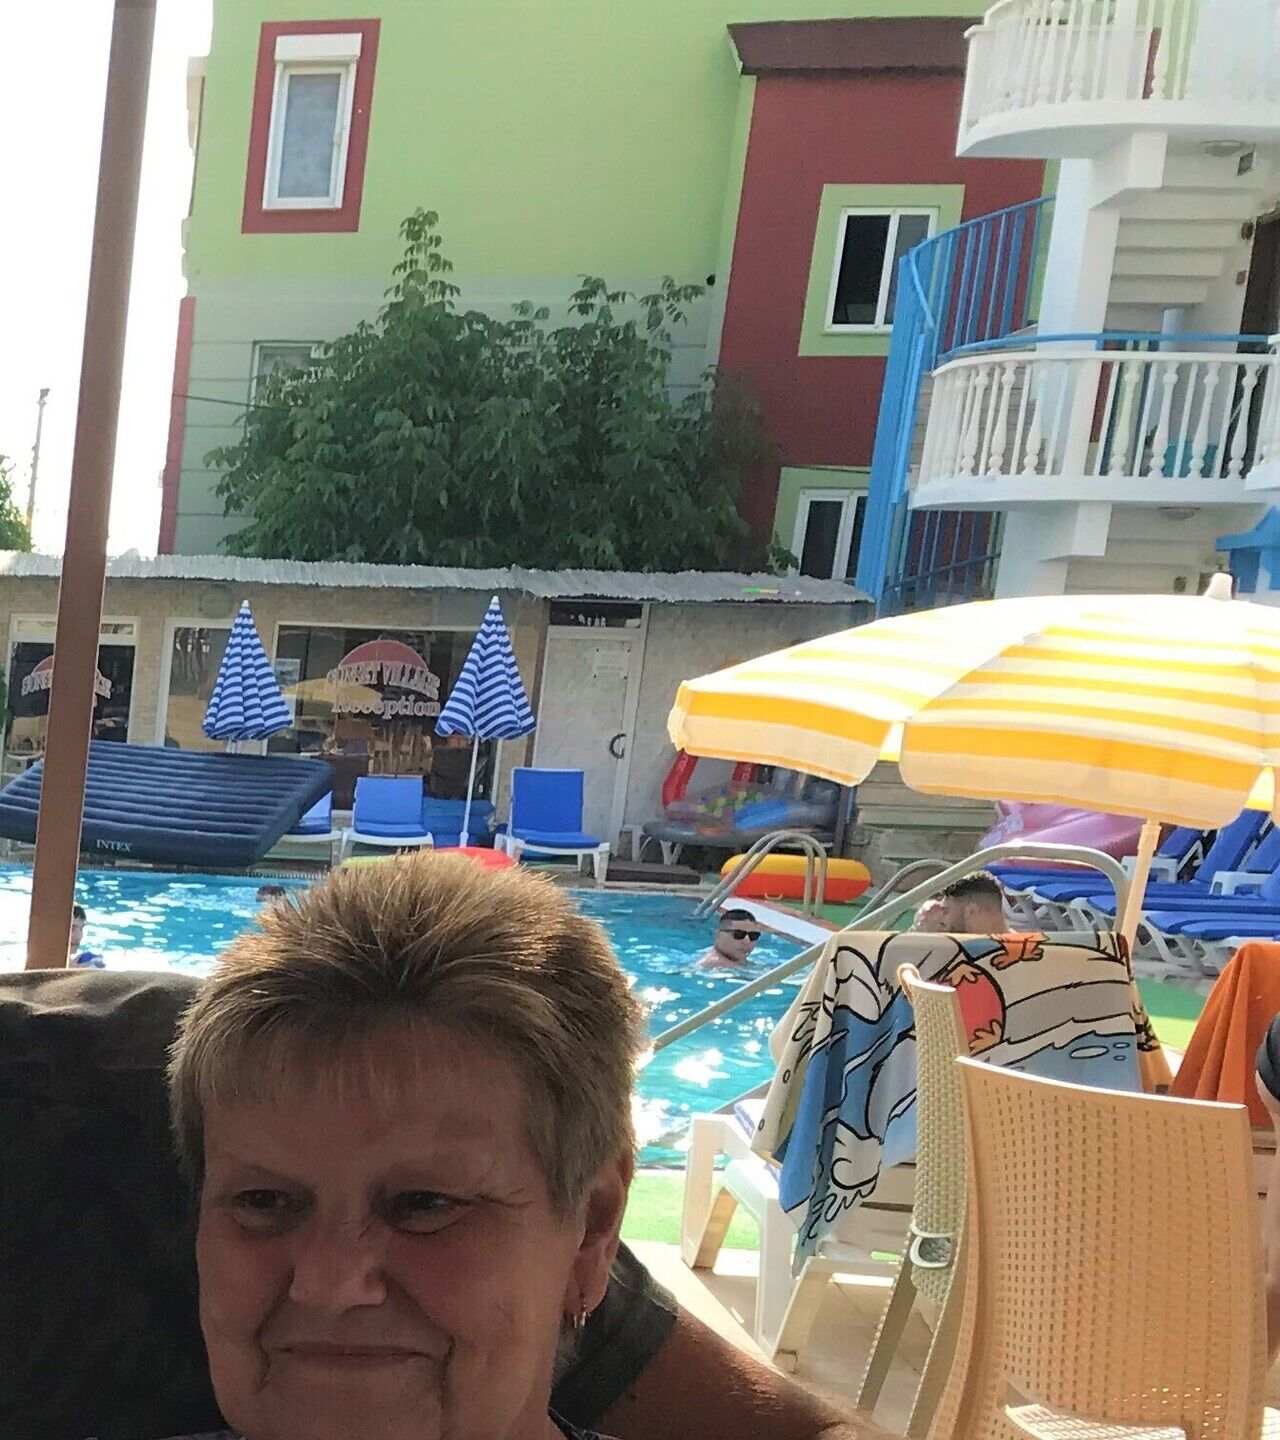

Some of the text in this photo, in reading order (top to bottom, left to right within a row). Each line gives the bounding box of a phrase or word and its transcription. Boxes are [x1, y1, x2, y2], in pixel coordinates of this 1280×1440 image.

[382, 660, 440, 701] VILLAGE
[332, 695, 441, 720] Reception
[96, 838, 134, 853] INTEX
